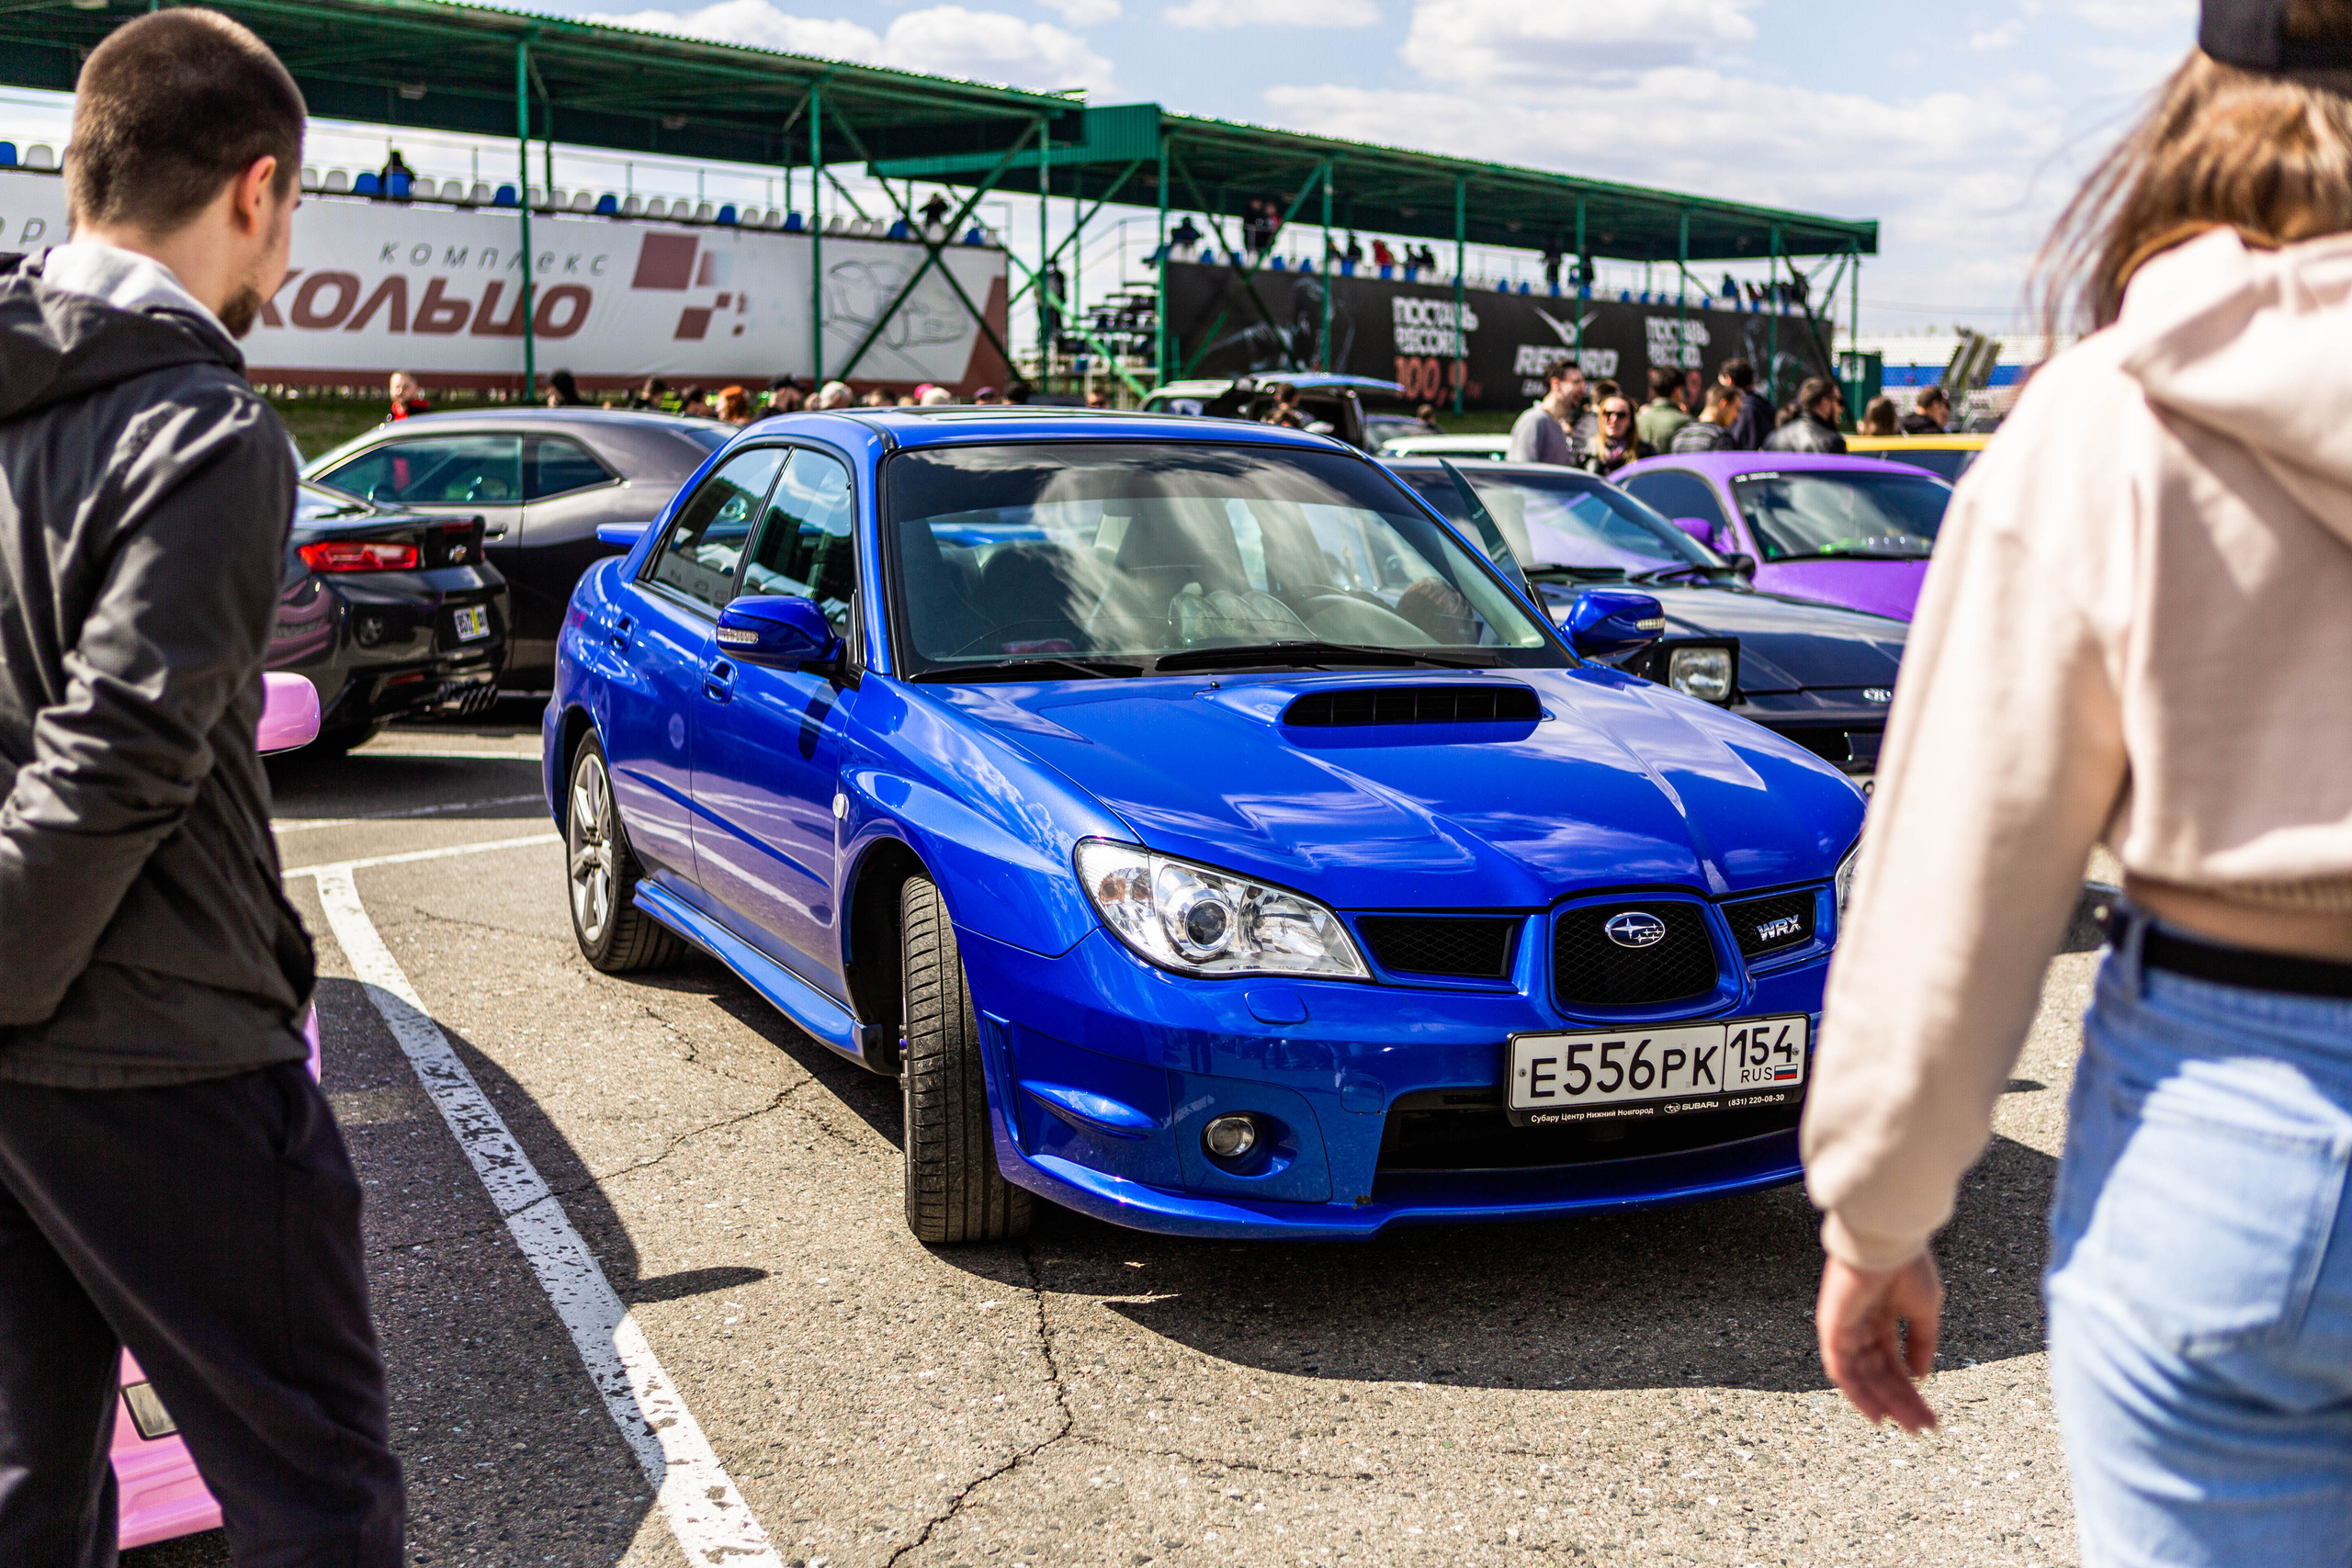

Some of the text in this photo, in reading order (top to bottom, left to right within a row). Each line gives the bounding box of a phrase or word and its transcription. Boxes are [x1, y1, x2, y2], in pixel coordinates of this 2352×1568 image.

[1514, 344, 1619, 378] RECRD
[1756, 914, 1802, 942] WRX
[1730, 1024, 1792, 1067] 154
[1740, 1066, 1773, 1083] RUS
[1681, 1101, 1719, 1111] SUBARU
[1728, 1093, 1785, 1107] (831) 220-08-30
[1531, 1108, 1654, 1123] Субару Центр Нижний Новгород
